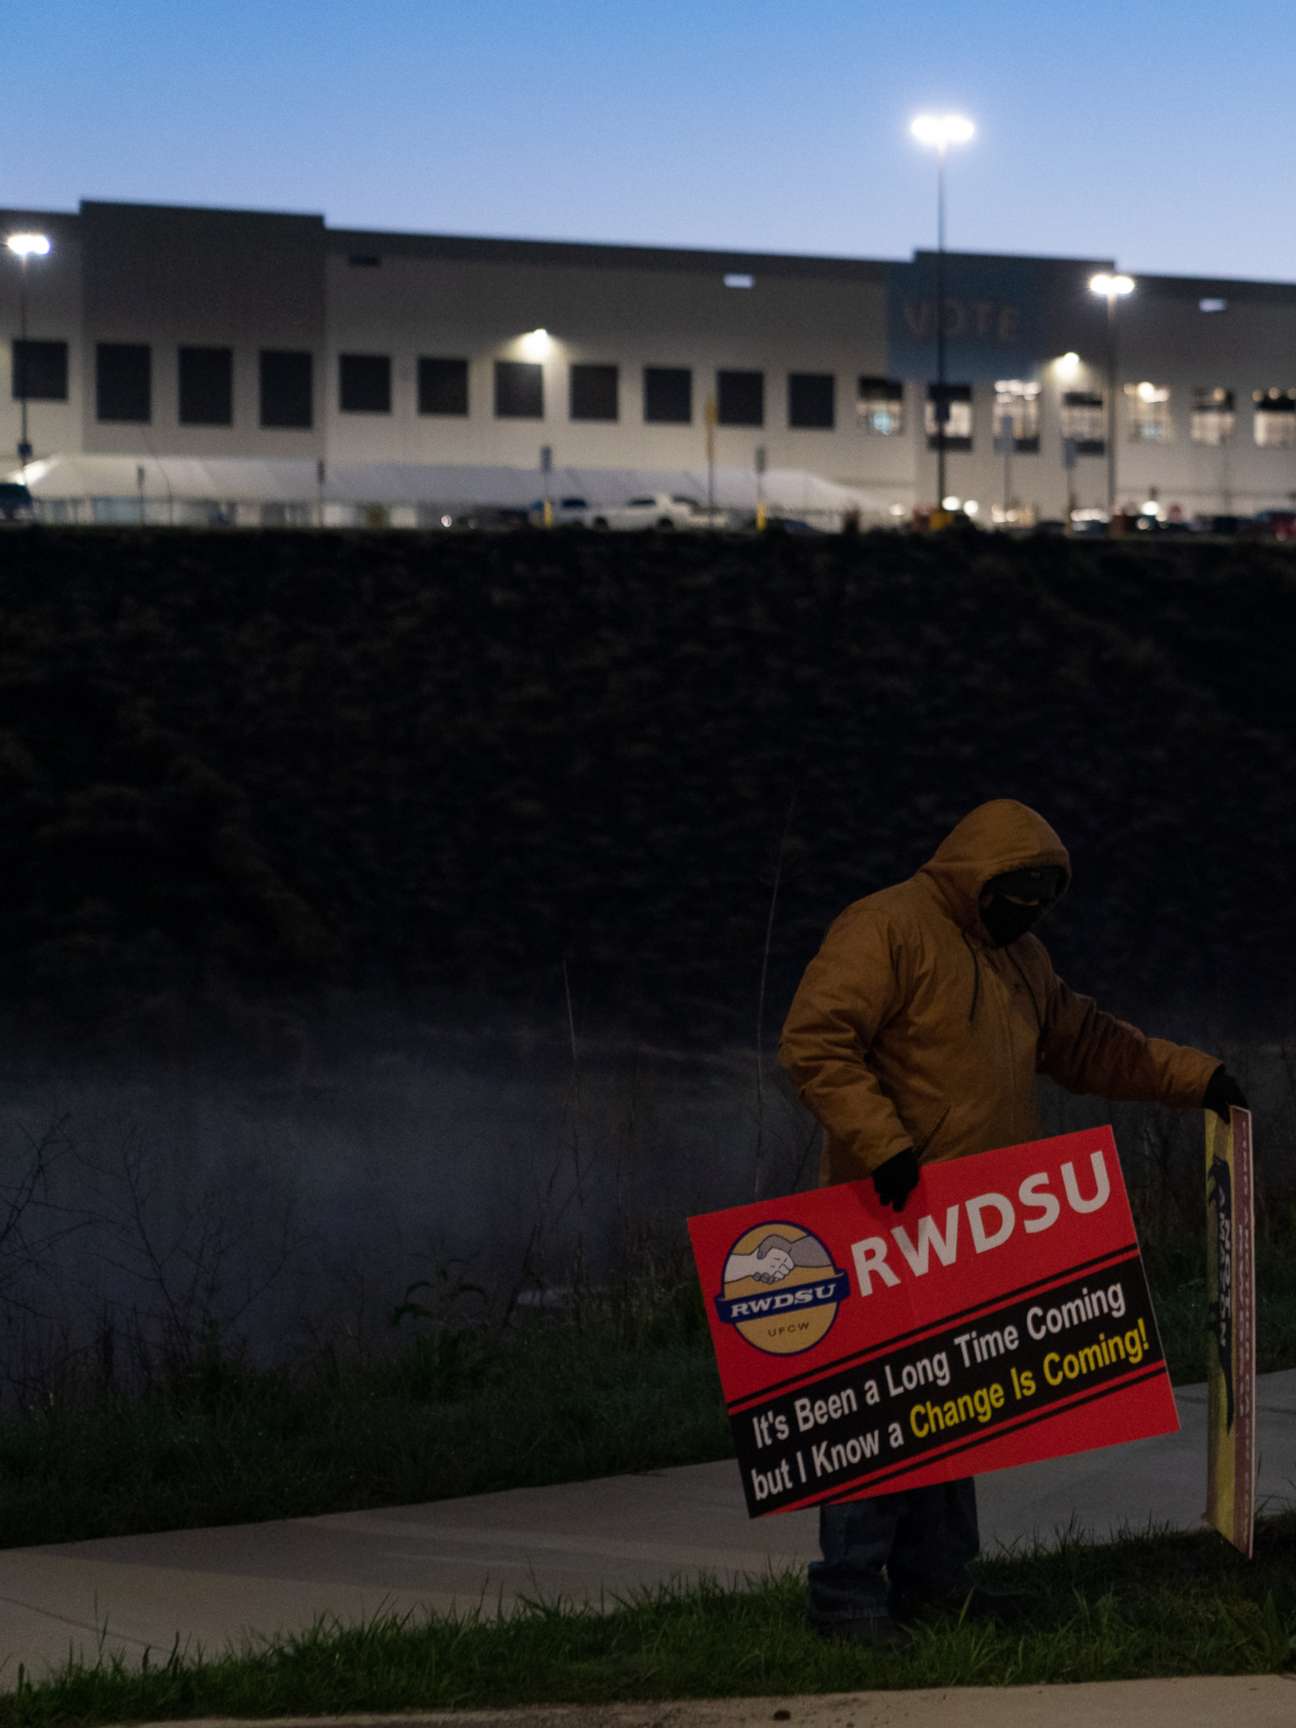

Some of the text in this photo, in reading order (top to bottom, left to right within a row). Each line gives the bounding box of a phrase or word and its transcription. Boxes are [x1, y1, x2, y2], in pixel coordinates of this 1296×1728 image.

[850, 1150, 1110, 1297] RWDSU
[730, 1283, 838, 1319] RWDSU
[752, 1281, 1125, 1448] It's Been a Long Time Coming
[767, 1322, 810, 1337] UFCW
[750, 1318, 1150, 1500] but I Know a Change Is Coming!
